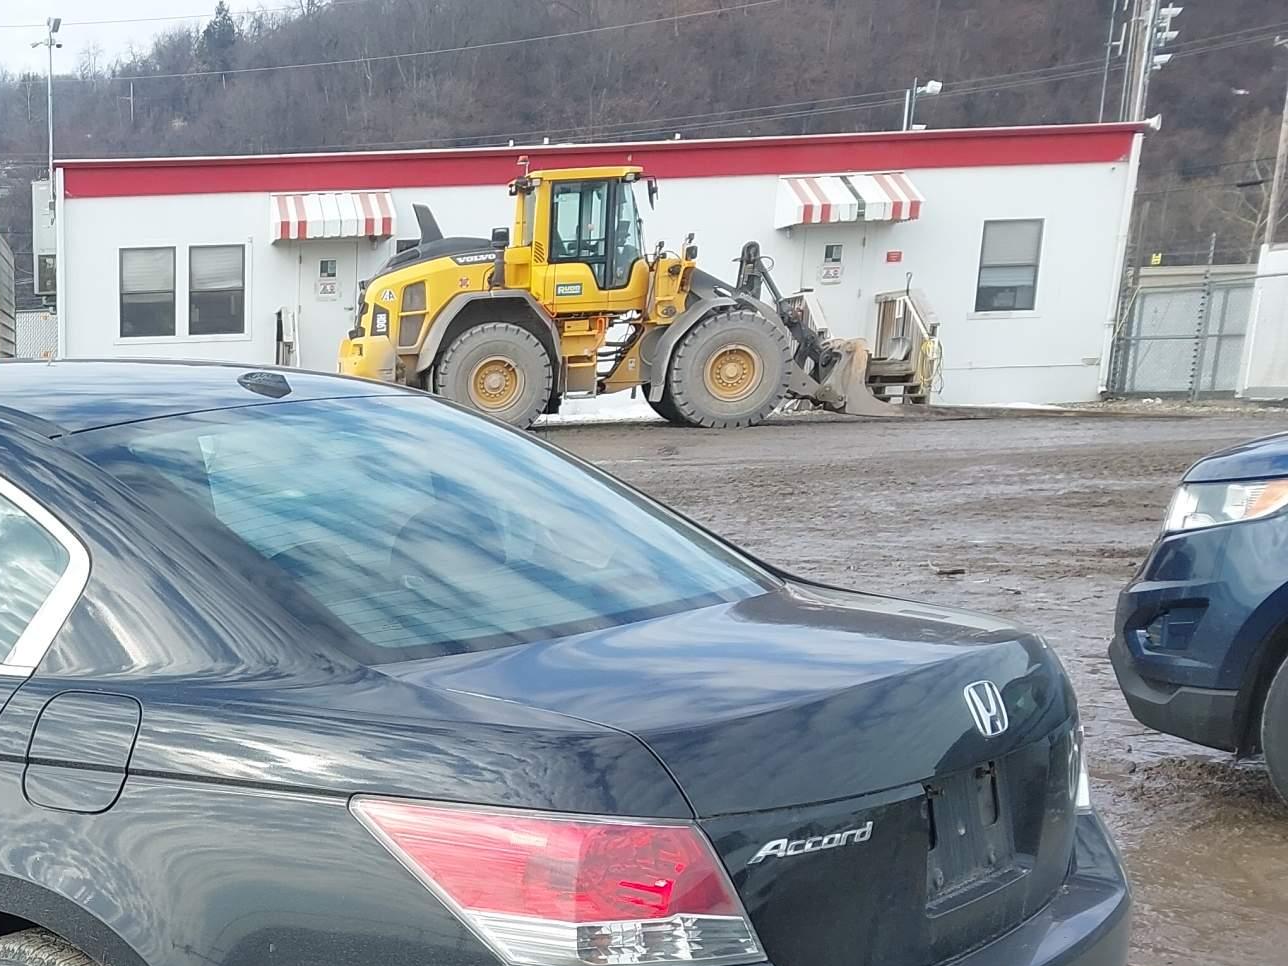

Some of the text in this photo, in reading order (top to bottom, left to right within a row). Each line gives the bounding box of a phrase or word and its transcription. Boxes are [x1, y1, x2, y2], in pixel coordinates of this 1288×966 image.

[456, 253, 497, 263] VOLVO
[376, 313, 387, 332] L90H
[747, 821, 874, 865] Accord
